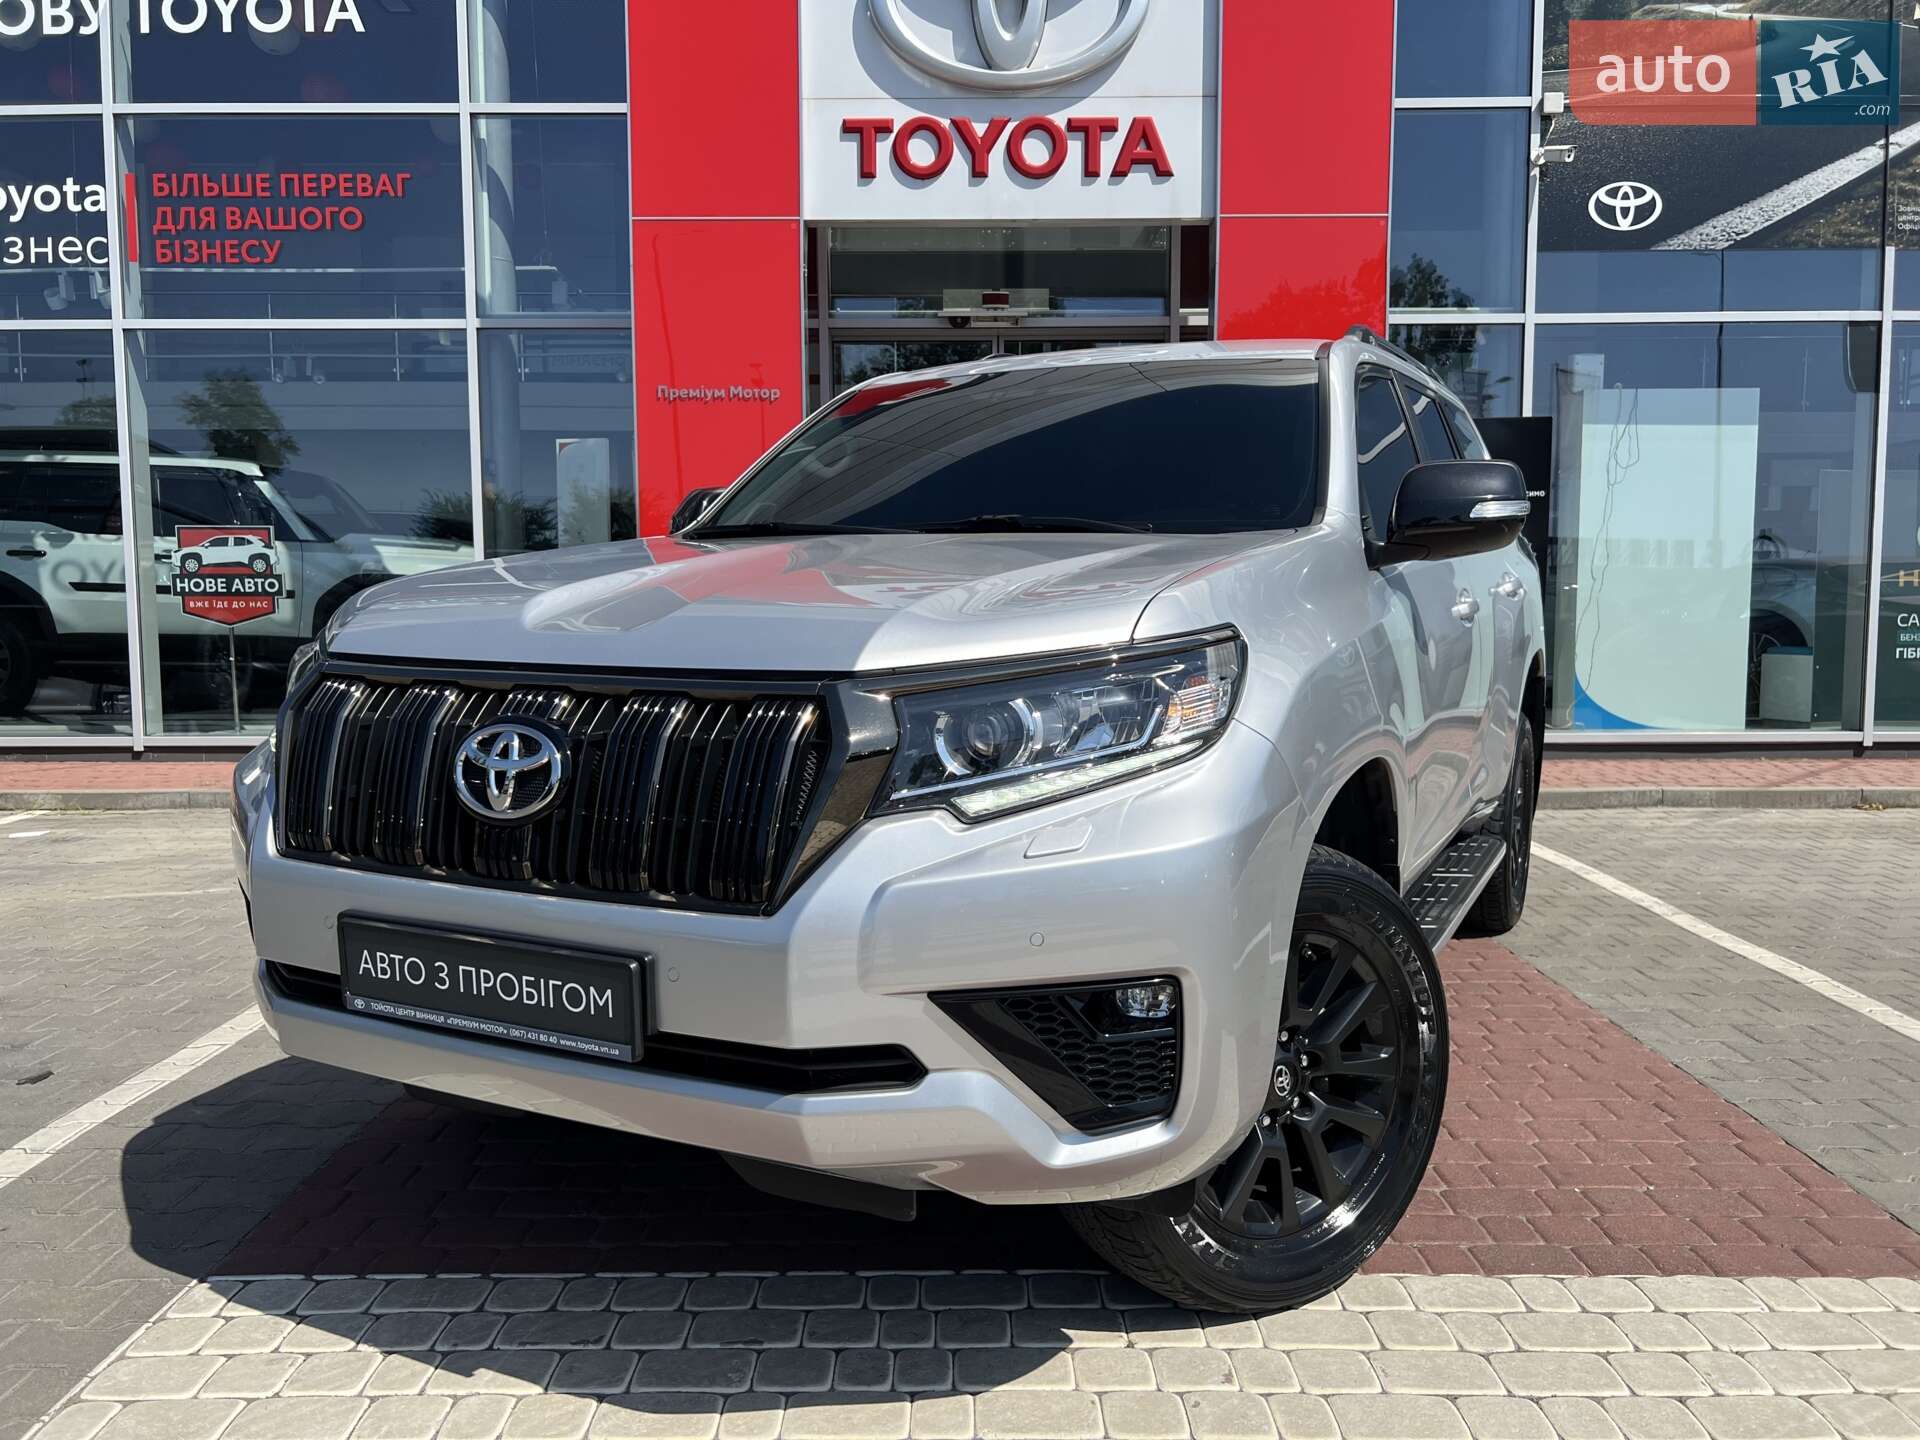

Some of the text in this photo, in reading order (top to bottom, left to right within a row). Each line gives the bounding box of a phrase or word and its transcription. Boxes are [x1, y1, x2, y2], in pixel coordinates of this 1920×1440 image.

[842, 116, 1175, 180] TOYOTA
[151, 173, 412, 198] БІЛЬШЕ ПЕРЕВАГ
[152, 206, 364, 236] ДЛЯ ВАШОГО
[155, 239, 282, 264] БІЗНЕСУ
[656, 384, 781, 402] Преміум Мотор
[176, 577, 280, 593] НОВЕ АВТО
[232, 600, 246, 609] ДО
[249, 600, 269, 608] НАС
[358, 949, 426, 985] АВТО
[458, 965, 613, 1018] ПРОБІГОМ
[395, 1007, 415, 1017] ЦЕНТР
[527, 1031, 539, 1041] 431
[539, 1034, 548, 1042] 80
[549, 1036, 558, 1044] 40
